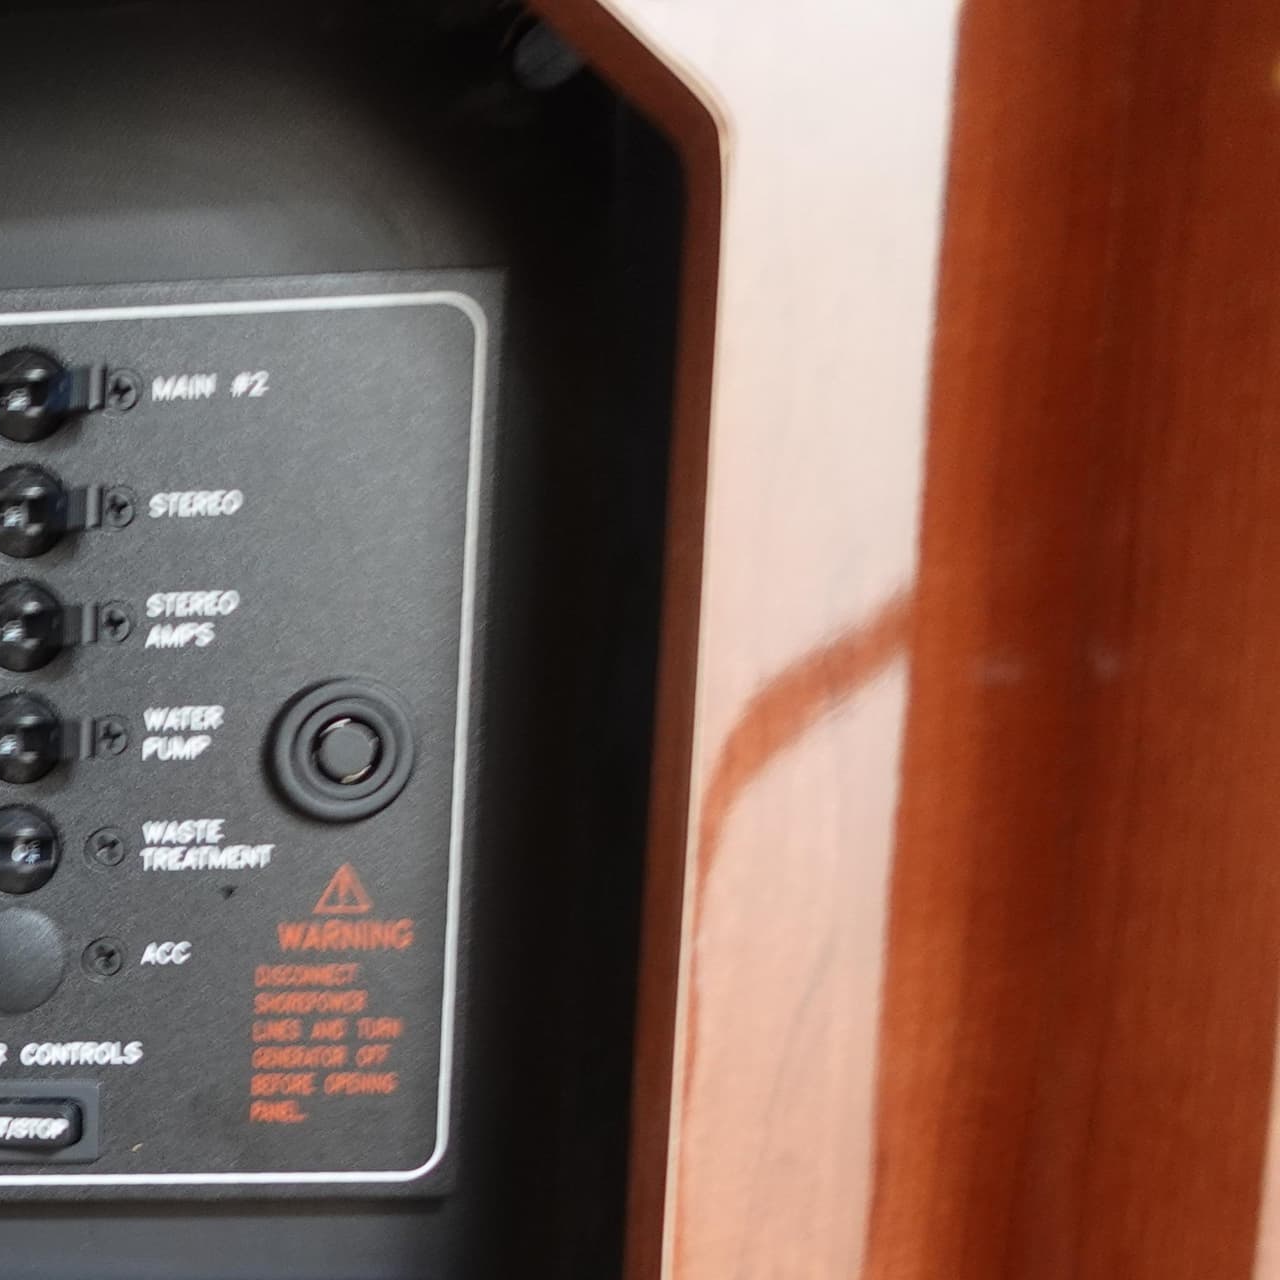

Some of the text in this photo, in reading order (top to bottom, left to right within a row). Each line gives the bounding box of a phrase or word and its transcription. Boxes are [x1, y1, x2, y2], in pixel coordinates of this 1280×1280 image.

[152, 370, 273, 401] MAIN #2
[149, 489, 243, 518] STEREO
[146, 590, 240, 617] STEREO
[145, 622, 215, 648] AMPS
[144, 705, 224, 731] WATER
[142, 735, 211, 760] PUMP
[142, 819, 225, 844] WASTE
[140, 844, 275, 871] TREATMENT
[278, 918, 415, 951] WARNING
[141, 941, 191, 965] ACC
[20, 1041, 144, 1066] CONTROLS
